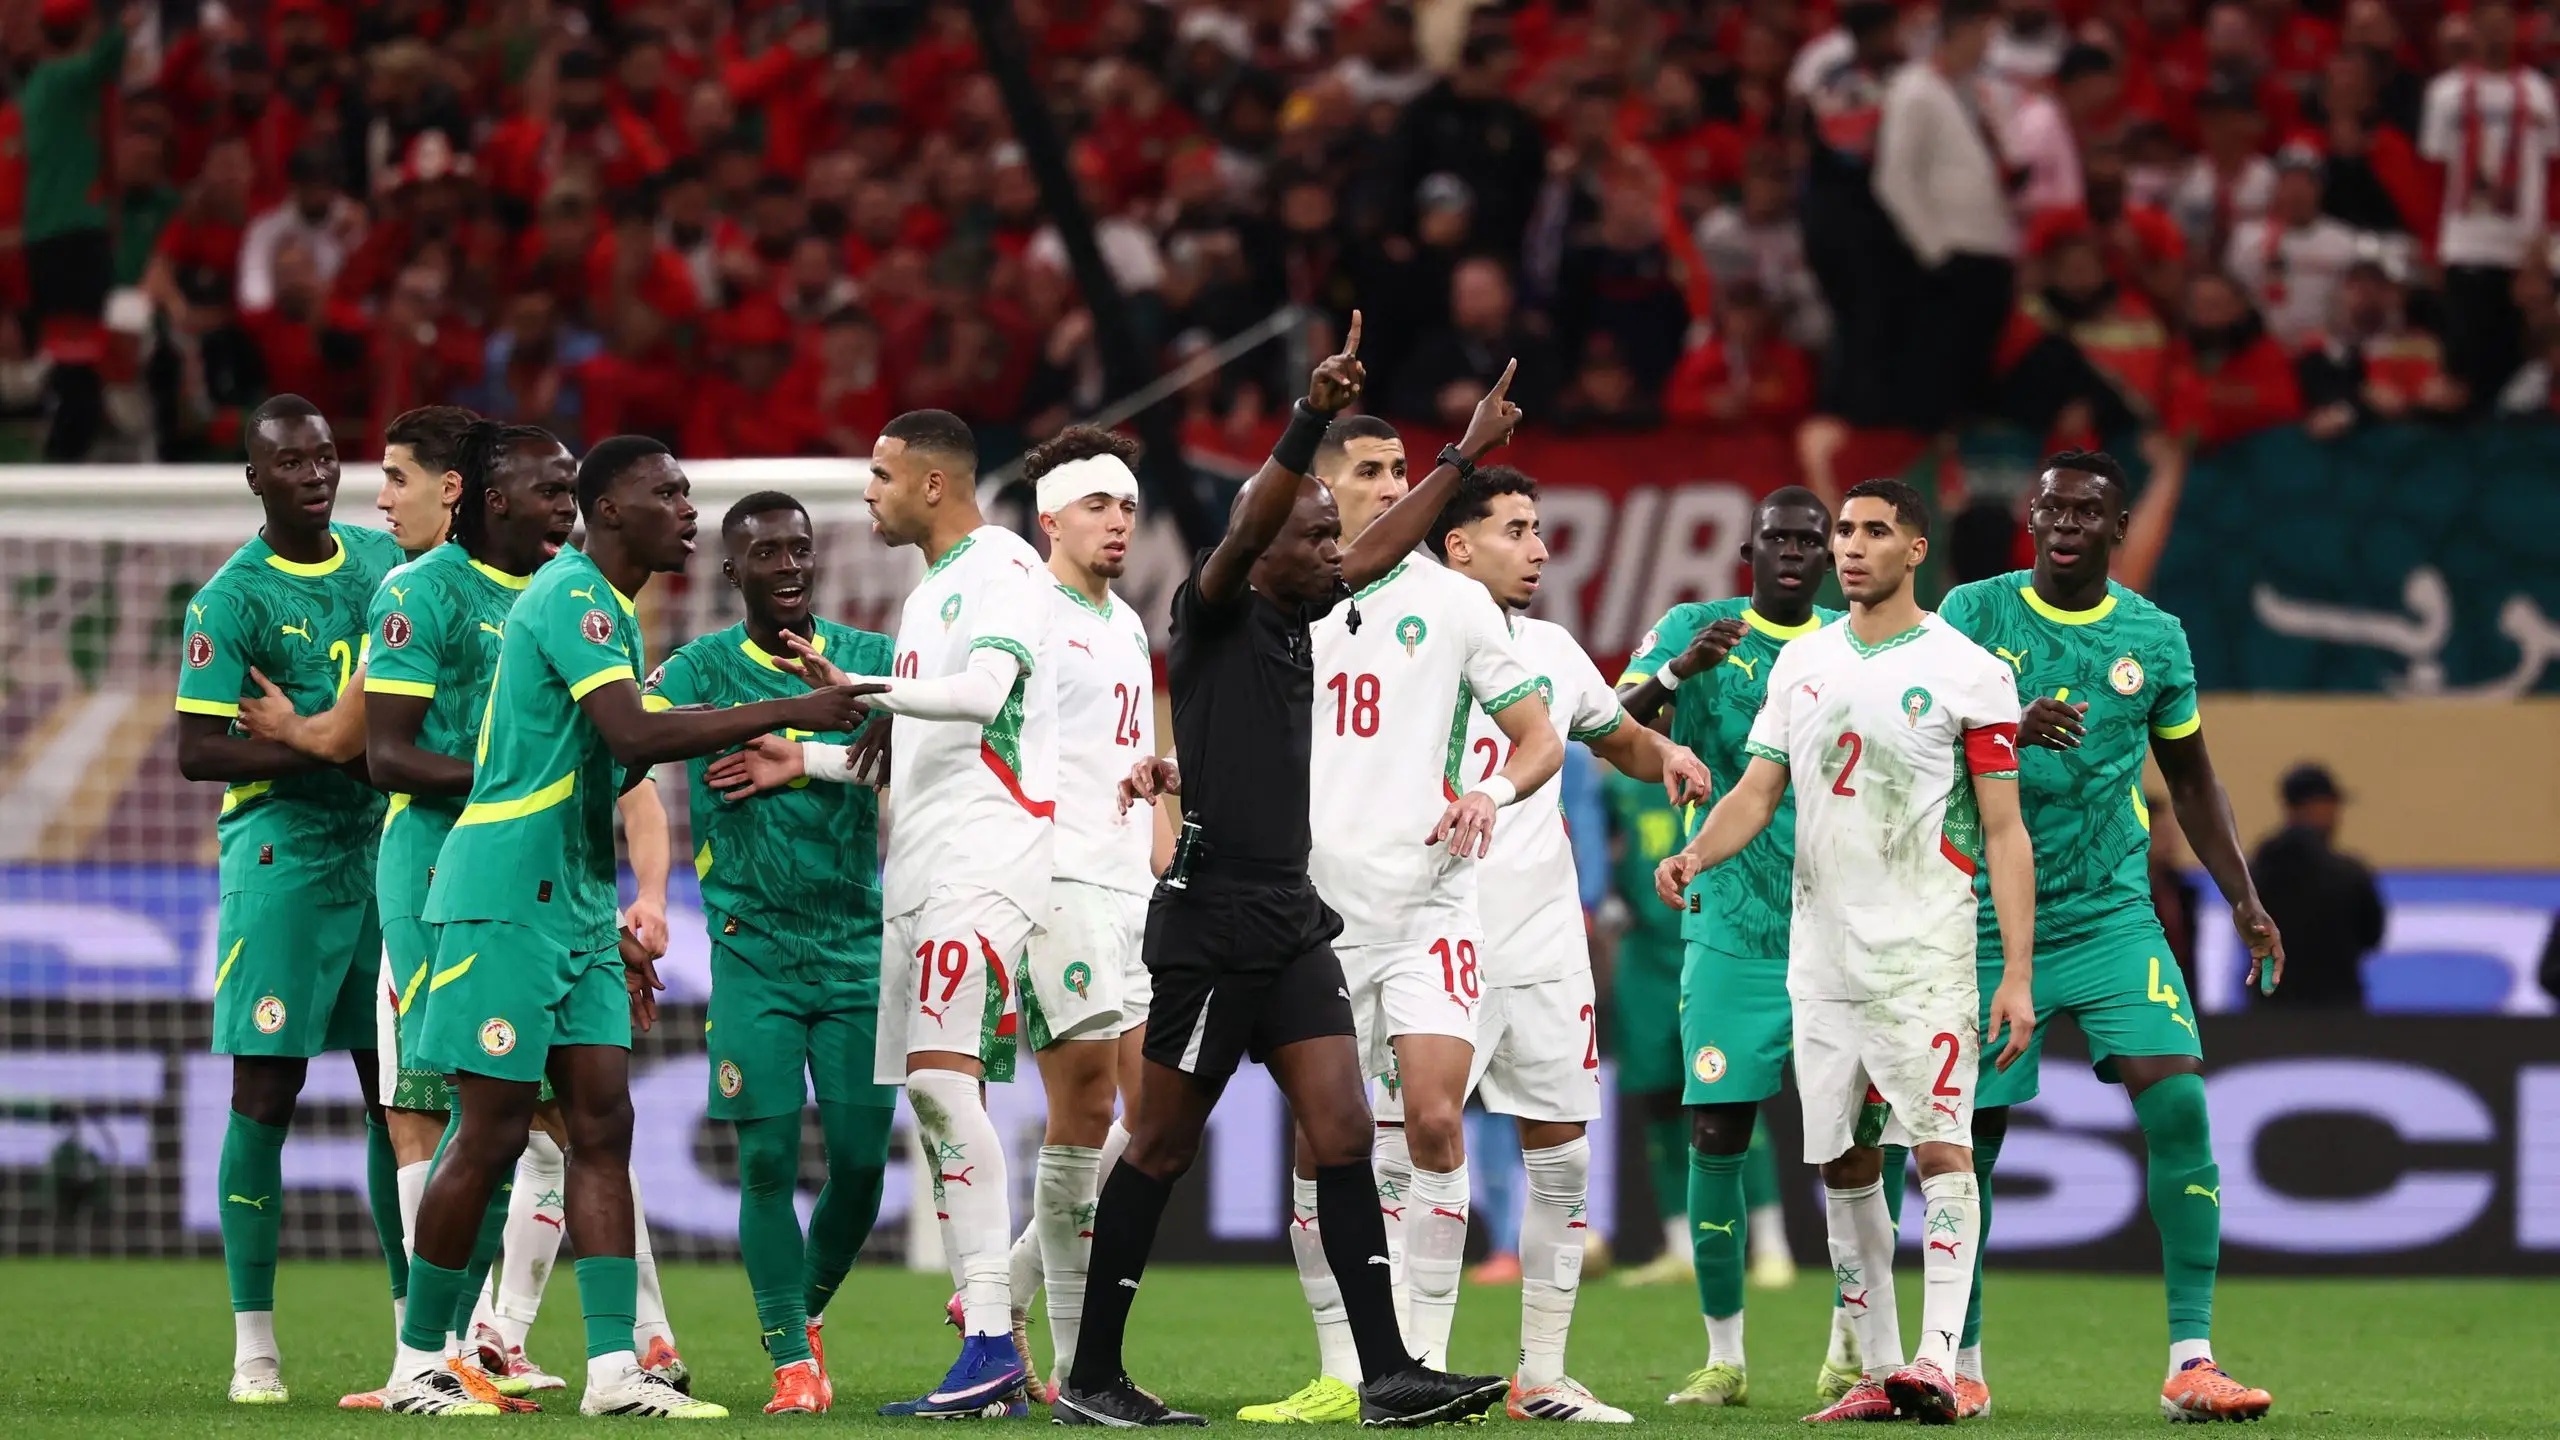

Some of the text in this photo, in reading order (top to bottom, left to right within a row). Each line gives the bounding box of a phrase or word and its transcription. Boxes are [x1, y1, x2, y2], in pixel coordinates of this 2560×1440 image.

[1533, 484, 1758, 656] RIB
[1114, 682, 1141, 748] 24
[1327, 672, 1381, 738] 18
[1473, 737, 1516, 782] 2
[1831, 731, 1863, 797] 2
[916, 939, 969, 1003] 19
[1428, 937, 1479, 999] 18
[2147, 957, 2180, 1009] 4
[1579, 1003, 1598, 1070] 2
[1931, 1032, 1962, 1096] 2
